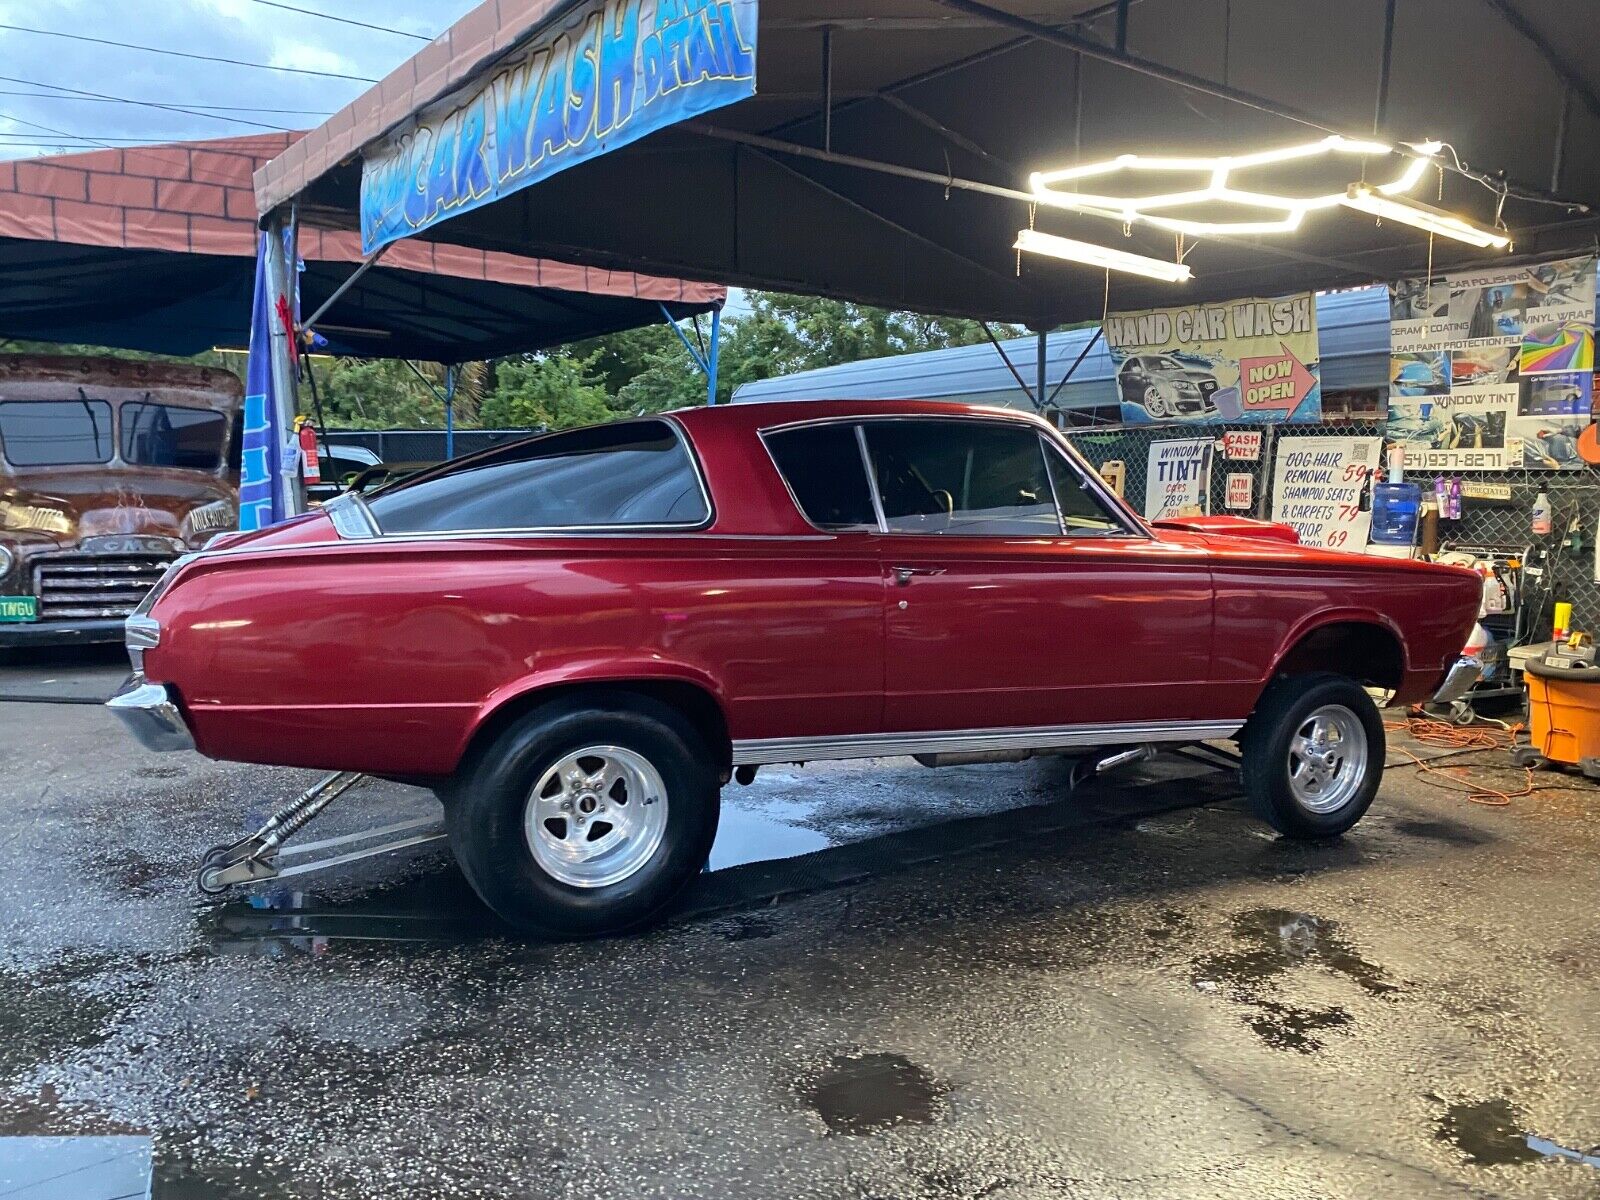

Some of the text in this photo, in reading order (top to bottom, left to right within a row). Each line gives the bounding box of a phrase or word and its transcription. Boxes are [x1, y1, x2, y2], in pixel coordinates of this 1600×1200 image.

[641, 0, 754, 107] DETAIL
[403, 86, 492, 228] CAR
[489, 0, 641, 184] WASH
[1449, 272, 1530, 289] CAR POLISHING
[1107, 297, 1311, 347] HAND CAR WASH
[1523, 313, 1554, 325] VINYL
[1557, 309, 1593, 321] WRAP
[1391, 321, 1470, 336] CERAMC COATING
[1389, 342, 1415, 352] LEAR
[1417, 341, 1442, 352] PAINT
[1443, 337, 1500, 350] PROTECTION
[1249, 360, 1294, 383] NOW
[1246, 381, 1295, 404] OPEN
[1433, 392, 1516, 407] WINDOW TINT
[1228, 435, 1259, 446] CASH
[1161, 445, 1202, 459] WINDOW
[1226, 447, 1257, 457] ONLY
[1286, 452, 1343, 468] DOG HAIR
[1388, 453, 1502, 468] (54)937-8271
[1157, 460, 1201, 482] TINT
[1284, 470, 1333, 484] REMOVAL
[1231, 479, 1248, 490] ATM
[1282, 486, 1355, 501] SHAMPOO SEATS
[1281, 505, 1361, 522] & CARPETS 79
[103, 540, 162, 551] GMC
[1327, 530, 1348, 548] 69
